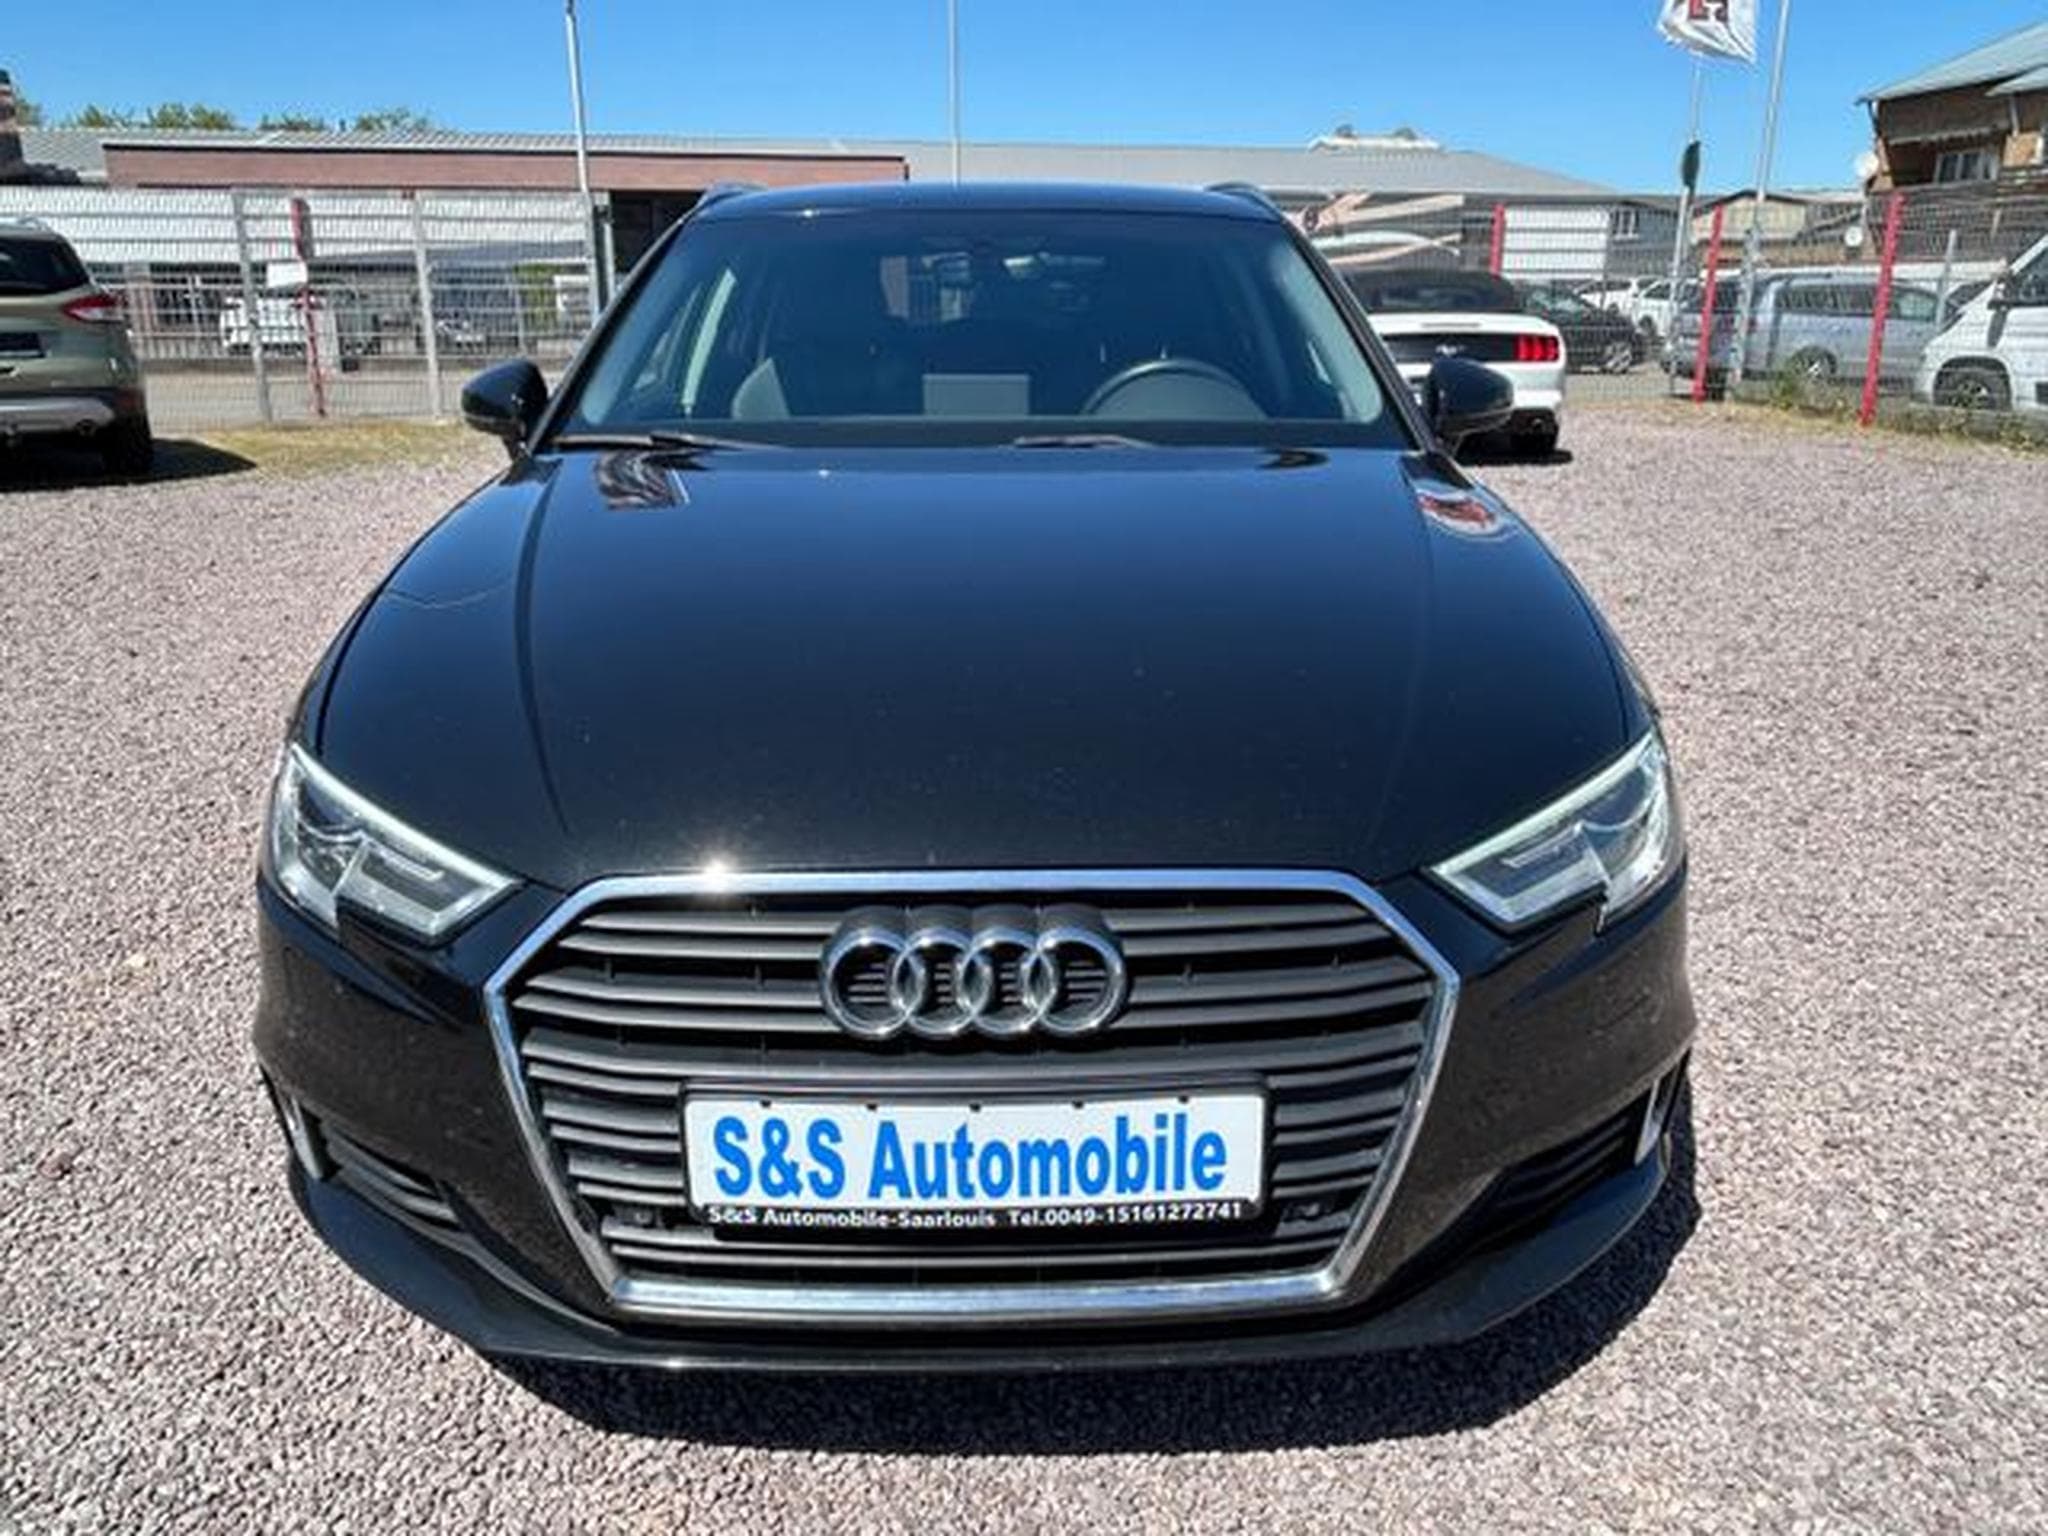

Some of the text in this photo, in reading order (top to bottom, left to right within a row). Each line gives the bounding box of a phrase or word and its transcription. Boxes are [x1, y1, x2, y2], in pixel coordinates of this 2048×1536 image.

[713, 1112, 1227, 1199] S&S Automobile
[708, 1206, 756, 1225] S&S
[762, 1208, 996, 1229] Automobile-Saarlouis
